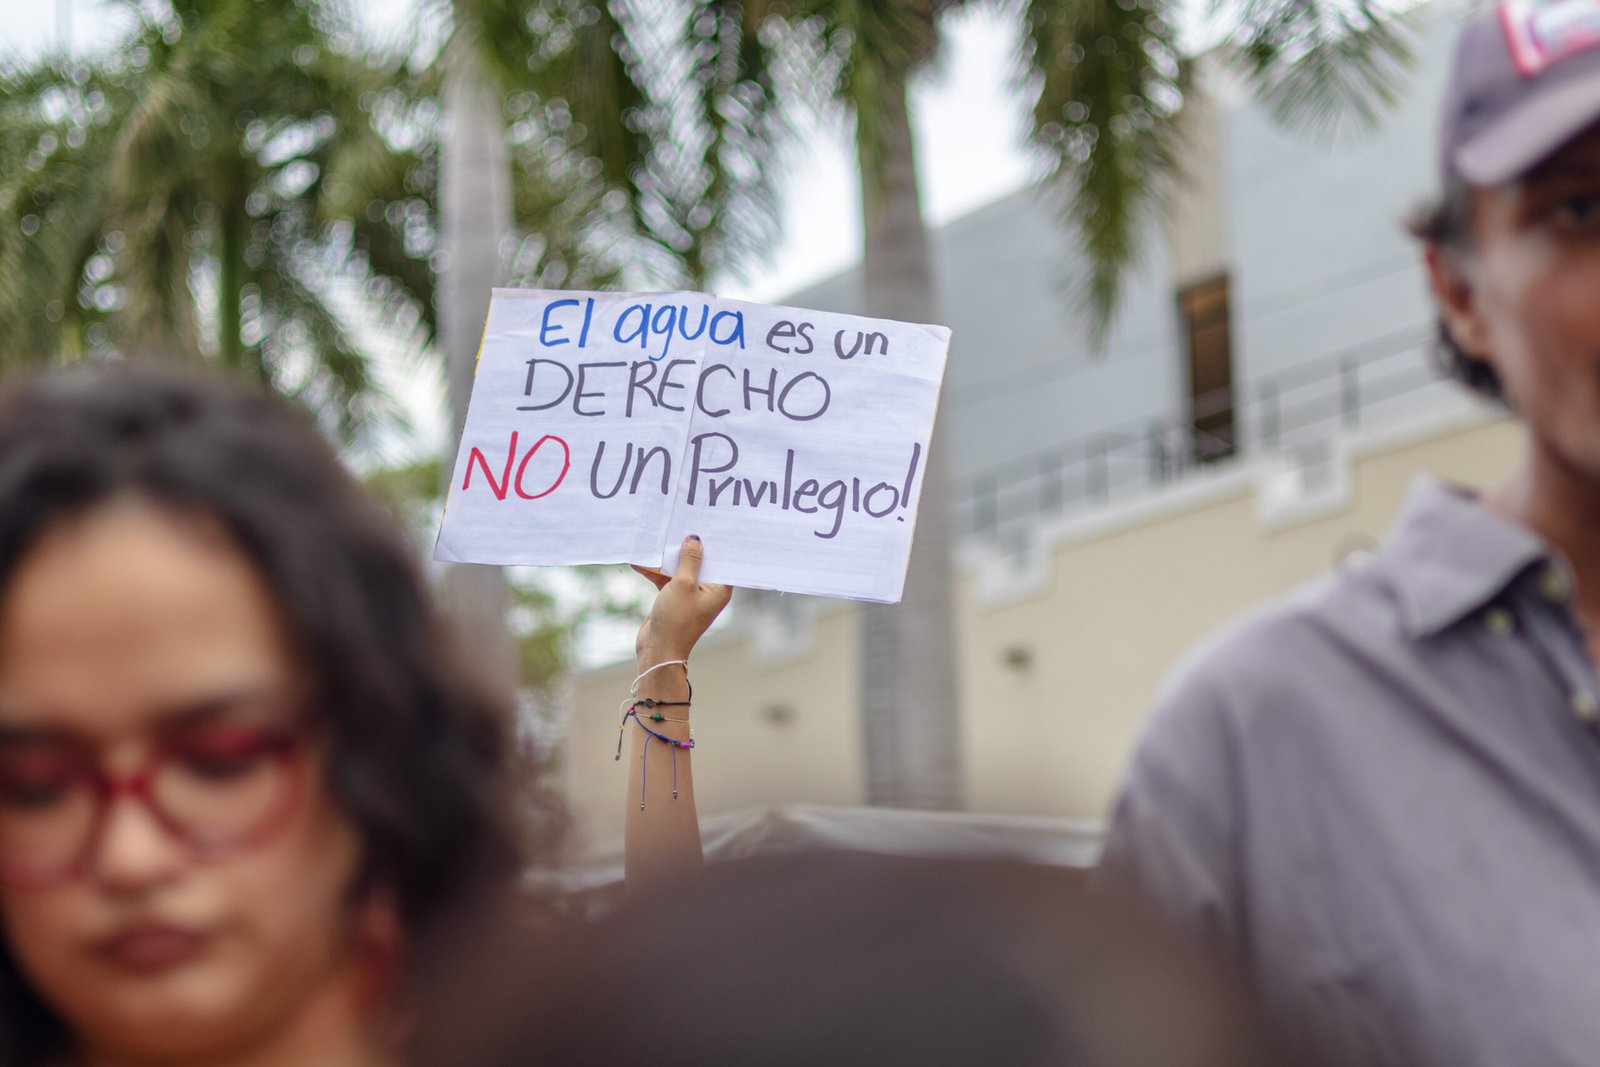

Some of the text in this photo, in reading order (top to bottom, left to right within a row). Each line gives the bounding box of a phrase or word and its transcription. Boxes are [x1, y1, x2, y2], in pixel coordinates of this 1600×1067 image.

[539, 298, 888, 361] El agua es un
[516, 358, 831, 422] DERECHO
[462, 431, 571, 501] NO
[686, 432, 921, 539] Privilegio!
